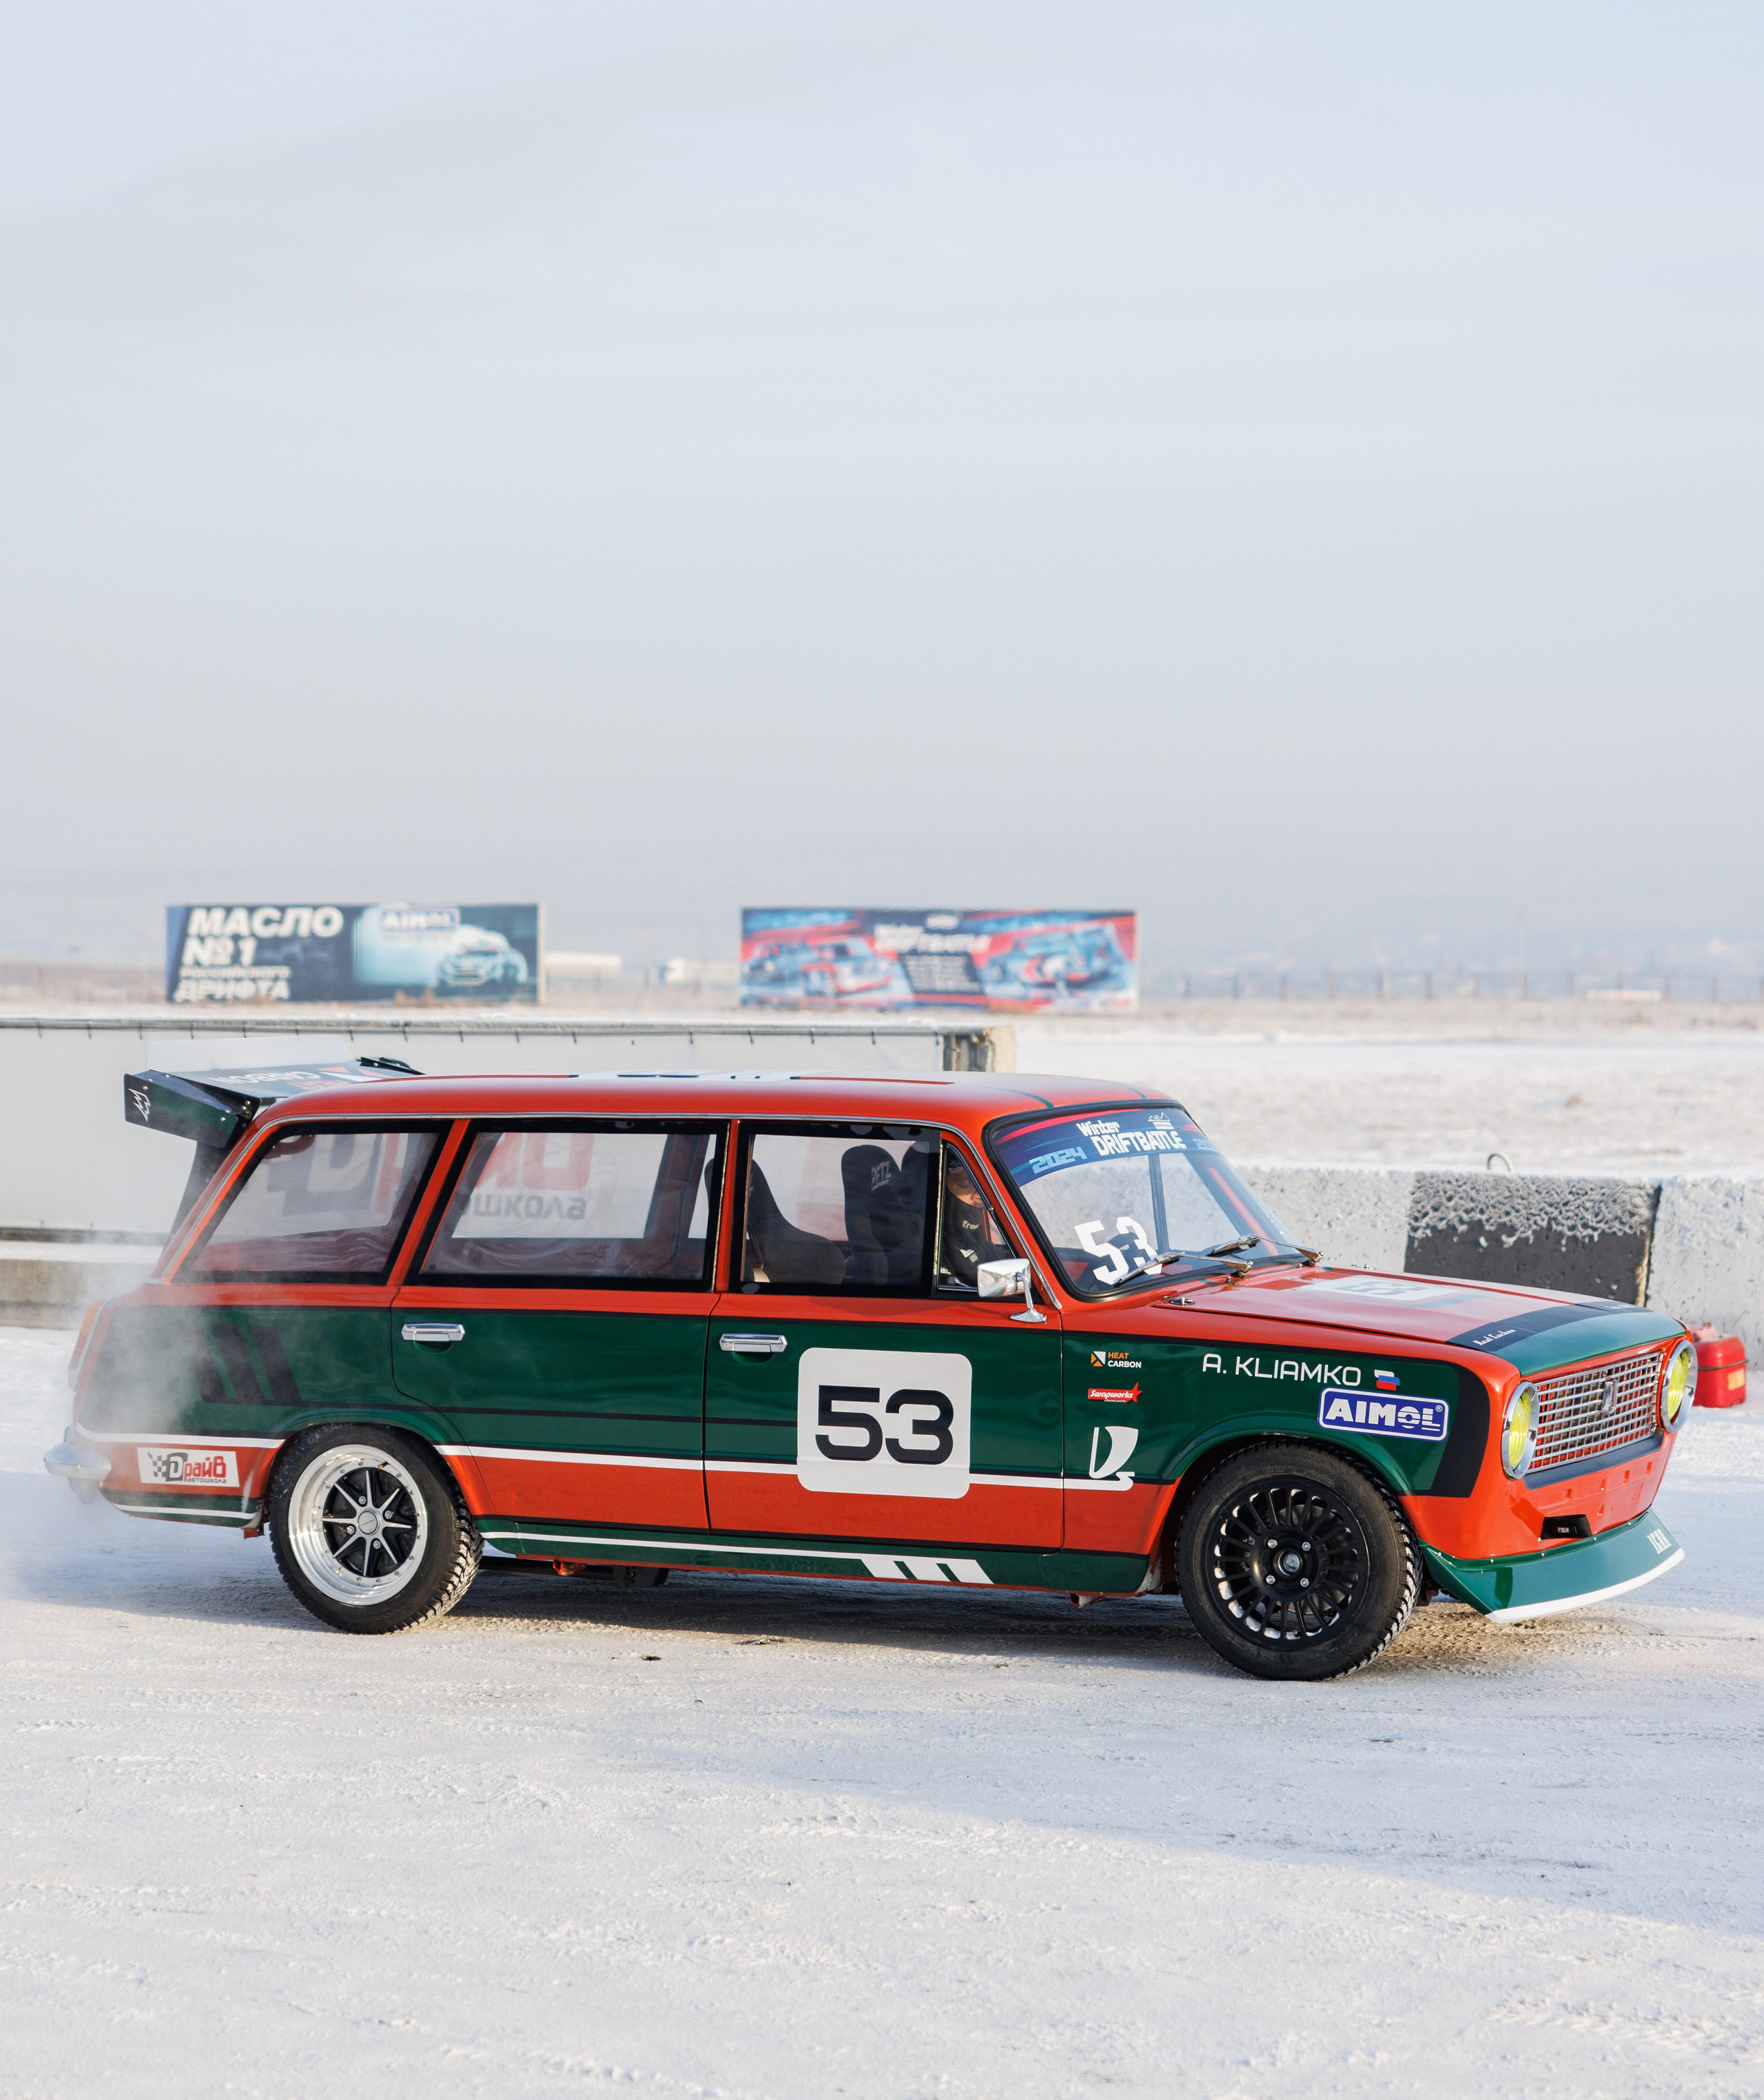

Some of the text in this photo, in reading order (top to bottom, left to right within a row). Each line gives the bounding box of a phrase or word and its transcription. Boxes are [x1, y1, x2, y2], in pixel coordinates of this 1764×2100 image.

[187, 906, 343, 937] МАСЛО
[1076, 1120, 1120, 1136] Winter
[1091, 1131, 1187, 1156] DRIFTBATTLE
[1029, 1146, 1087, 1174] 2024
[1074, 1216, 1162, 1285] 53
[1107, 1360, 1142, 1368] CARBON
[1202, 1354, 1361, 1387] A. KLIAMKO
[1089, 1389, 1134, 1399] Swapworks
[815, 1385, 954, 1465] 53
